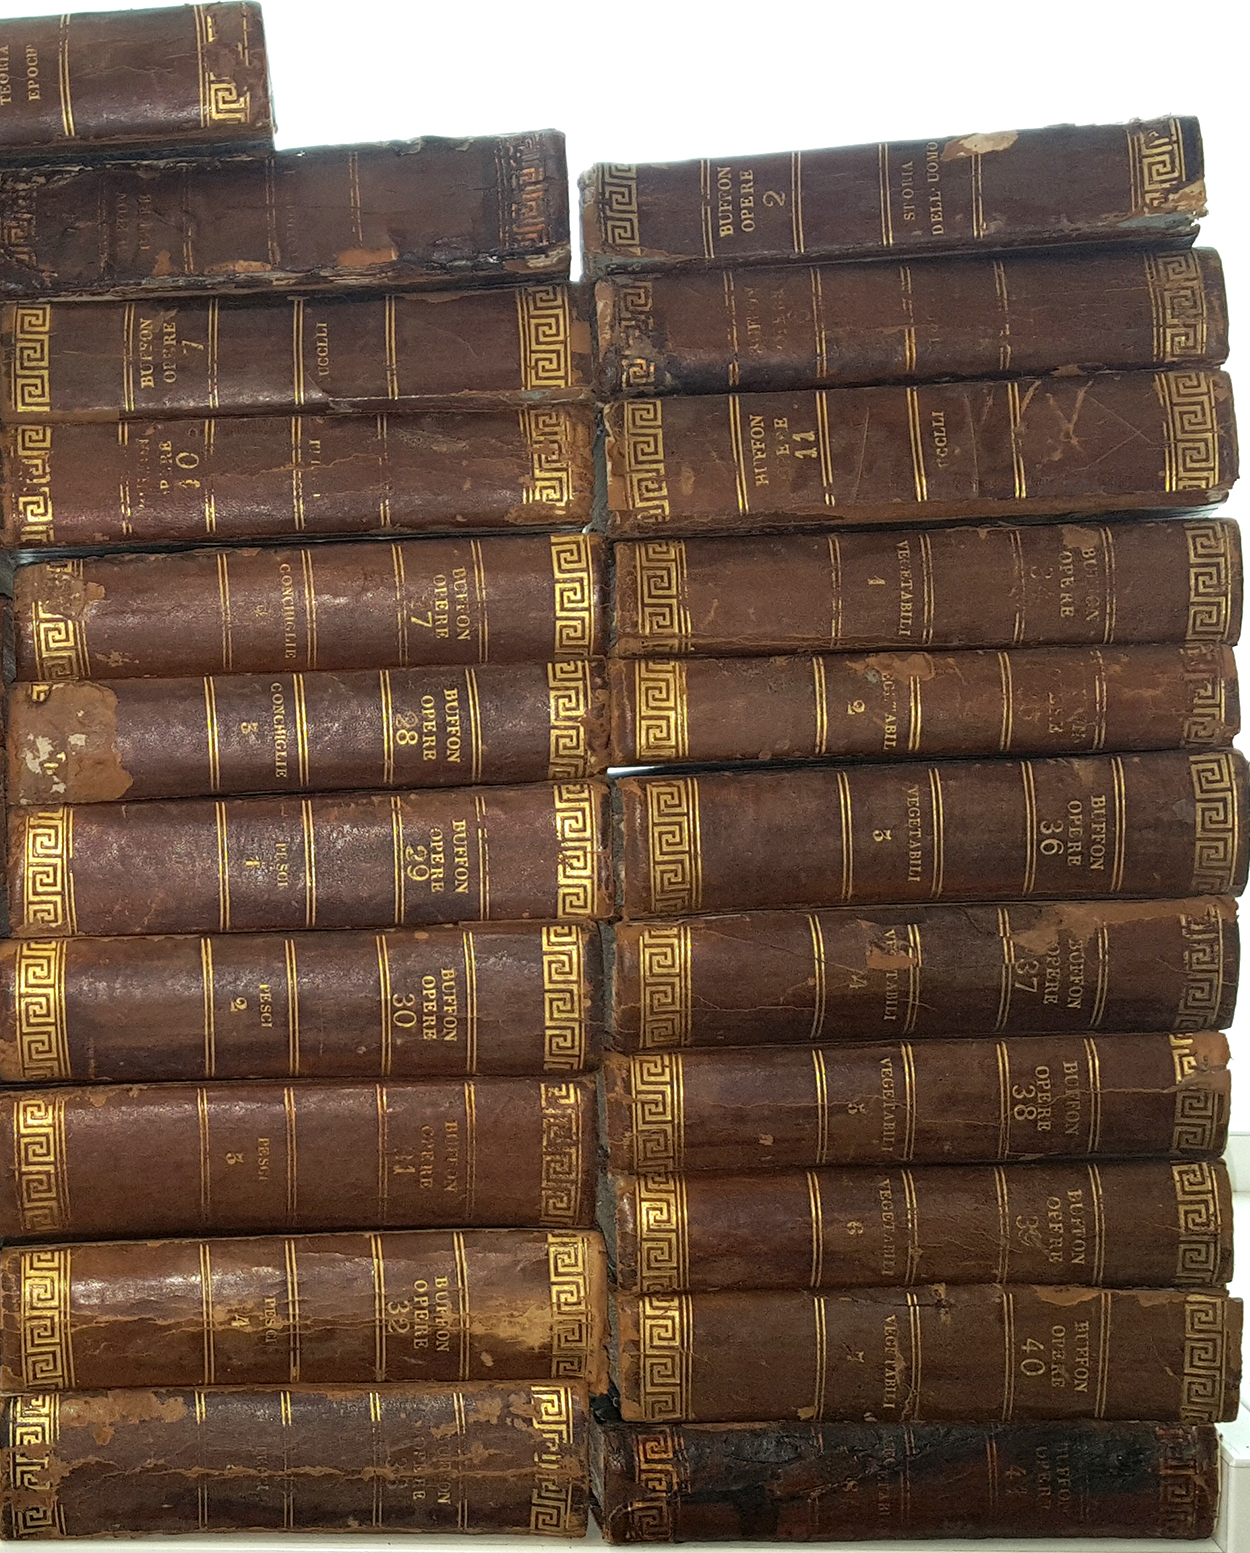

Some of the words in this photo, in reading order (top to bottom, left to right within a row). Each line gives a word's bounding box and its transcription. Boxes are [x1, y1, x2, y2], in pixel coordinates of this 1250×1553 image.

[900, 160, 916, 221] STORIA
[926, 142, 939, 182] UOMO
[717, 166, 734, 237] BUFFON
[740, 169, 755, 232] OPERE
[762, 190, 786, 207] 2
[929, 188, 945, 236] DELL'
[792, 430, 818, 459] 11
[433, 574, 449, 639] OPERE
[452, 567, 471, 641] BUFFON
[867, 575, 886, 586] 1
[1058, 550, 1075, 618] OPERE
[270, 682, 288, 778] CONCHIGLIE
[395, 712, 419, 746] 28
[420, 695, 437, 761] OPERE
[444, 688, 462, 763] BUFFON
[847, 699, 866, 715] 2
[405, 845, 431, 881] 29
[429, 827, 445, 893] OPERE
[452, 819, 469, 894] BUFFON
[872, 829, 893, 842] 3
[903, 784, 922, 883] VEGETABILI
[1039, 819, 1065, 856] 36
[1067, 800, 1083, 867] OPERE
[1090, 794, 1106, 871] BUFFON
[230, 997, 248, 1012] 2
[441, 968, 458, 1042] BUFFON
[849, 973, 868, 989] 4
[1014, 958, 1039, 994] 37
[1043, 943, 1061, 1006] OPERE
[1067, 938, 1085, 1010] BUFFON
[259, 983, 273, 1029] PESCI
[392, 993, 418, 1028] 30
[421, 975, 438, 1041] OPERE
[1012, 1084, 1037, 1120] 38
[1035, 1065, 1052, 1132] OPERE
[1062, 1060, 1081, 1136] BUFFON
[226, 1152, 245, 1165] 3
[231, 1313, 251, 1327] 4
[264, 1297, 278, 1344] PESCI
[387, 1300, 410, 1334] 32
[413, 1279, 429, 1349] OPERE
[434, 1276, 450, 1352] BUFFON
[882, 1314, 899, 1408] VEGETABILI
[1020, 1338, 1045, 1377] 40
